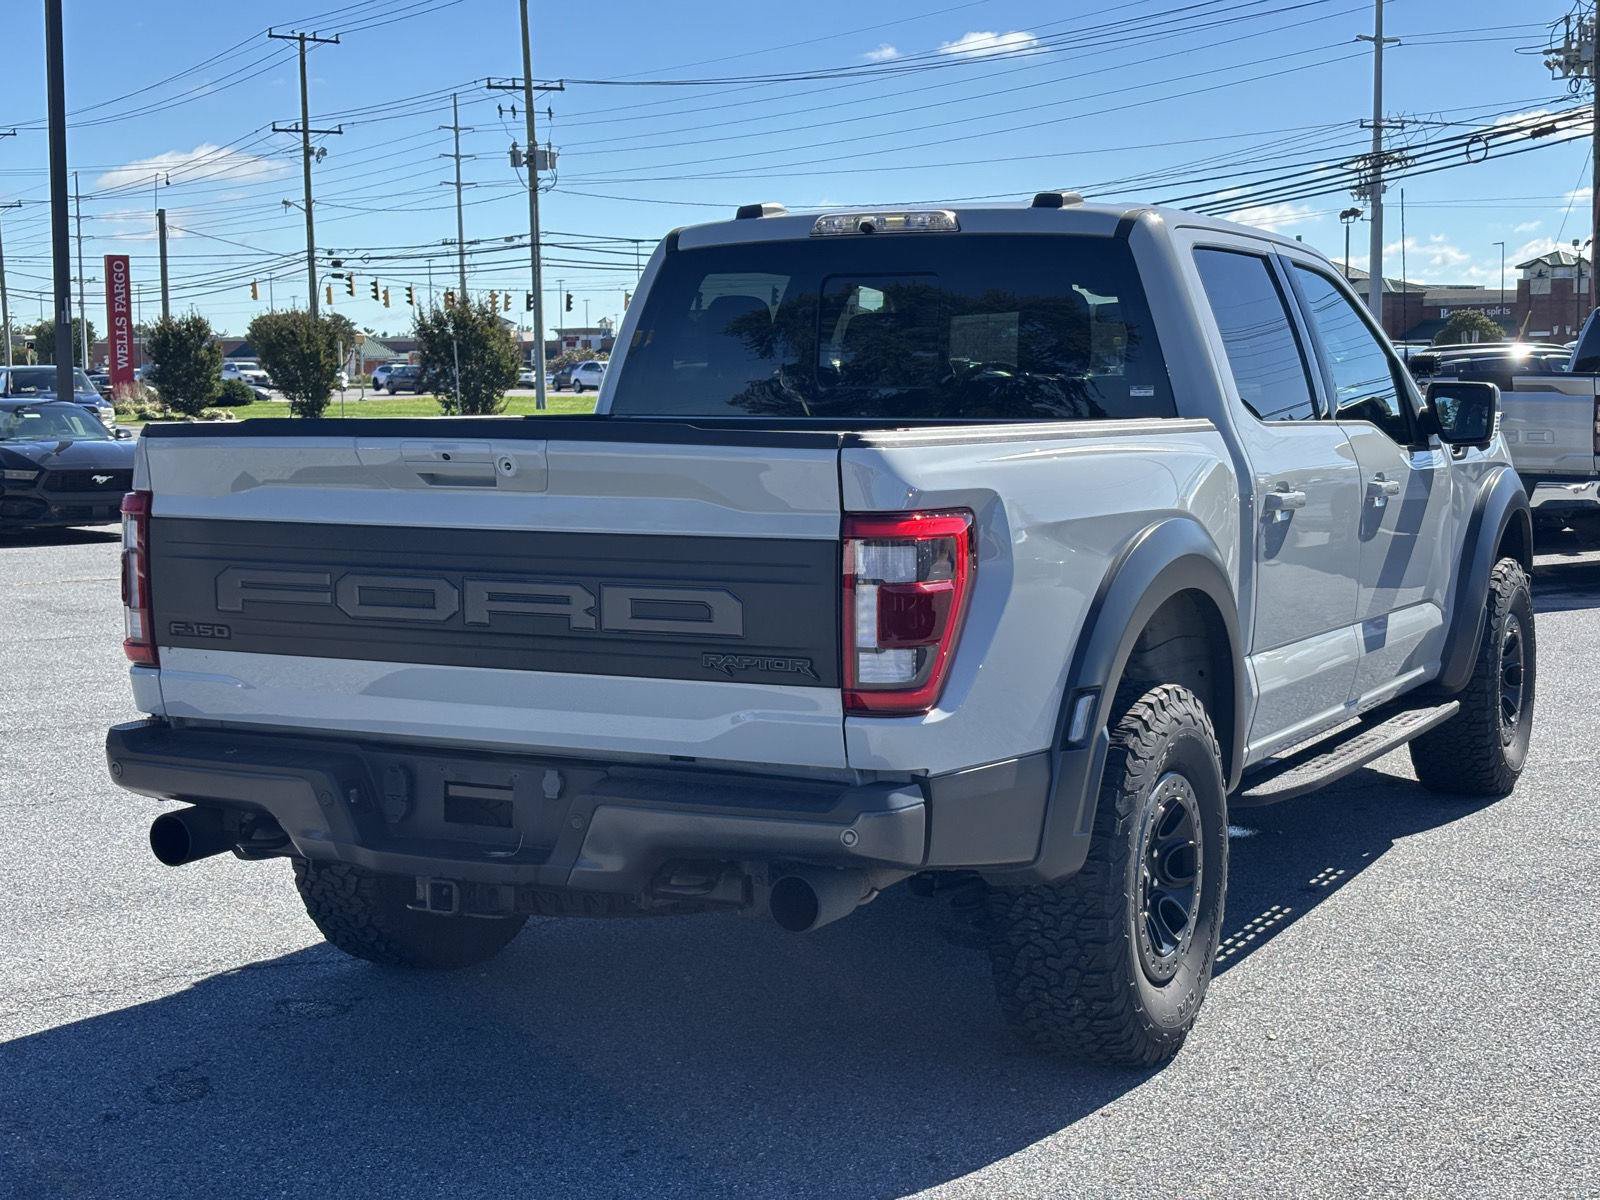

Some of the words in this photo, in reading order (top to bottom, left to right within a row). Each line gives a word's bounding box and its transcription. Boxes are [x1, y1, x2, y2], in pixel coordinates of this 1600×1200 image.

[112, 260, 127, 313] FARGO
[1486, 305, 1511, 318] spirts
[115, 317, 129, 370] WELLS
[215, 566, 744, 638] FORD
[169, 621, 231, 639] F-150
[702, 653, 820, 681] RAPTOR
